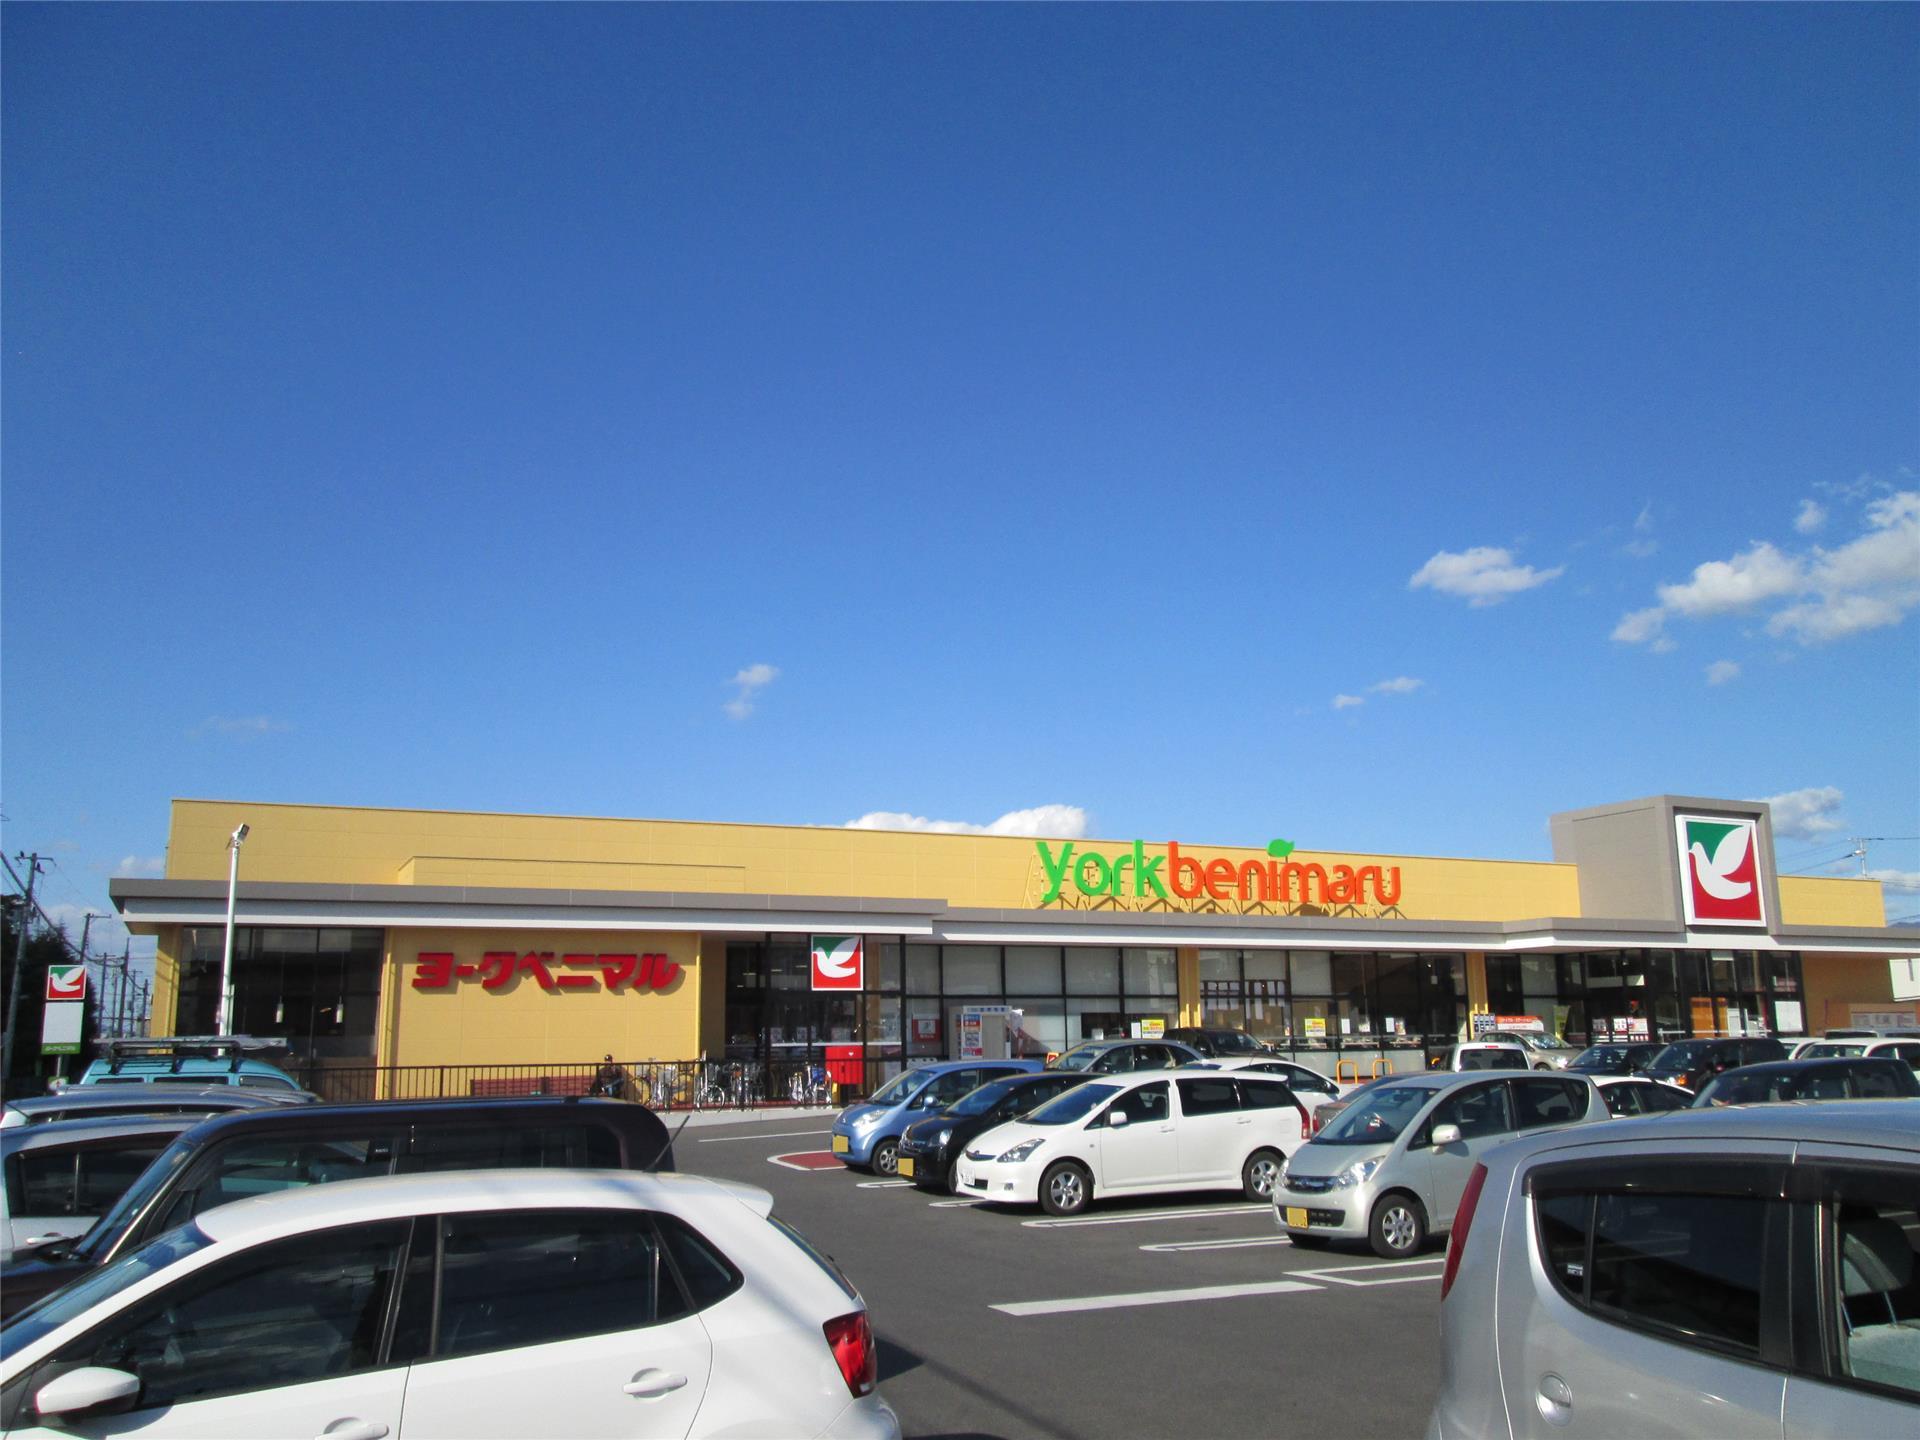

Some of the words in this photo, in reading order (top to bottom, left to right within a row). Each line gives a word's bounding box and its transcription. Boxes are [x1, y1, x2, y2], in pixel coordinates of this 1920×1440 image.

[412, 951, 680, 989] ヨークベニマル
